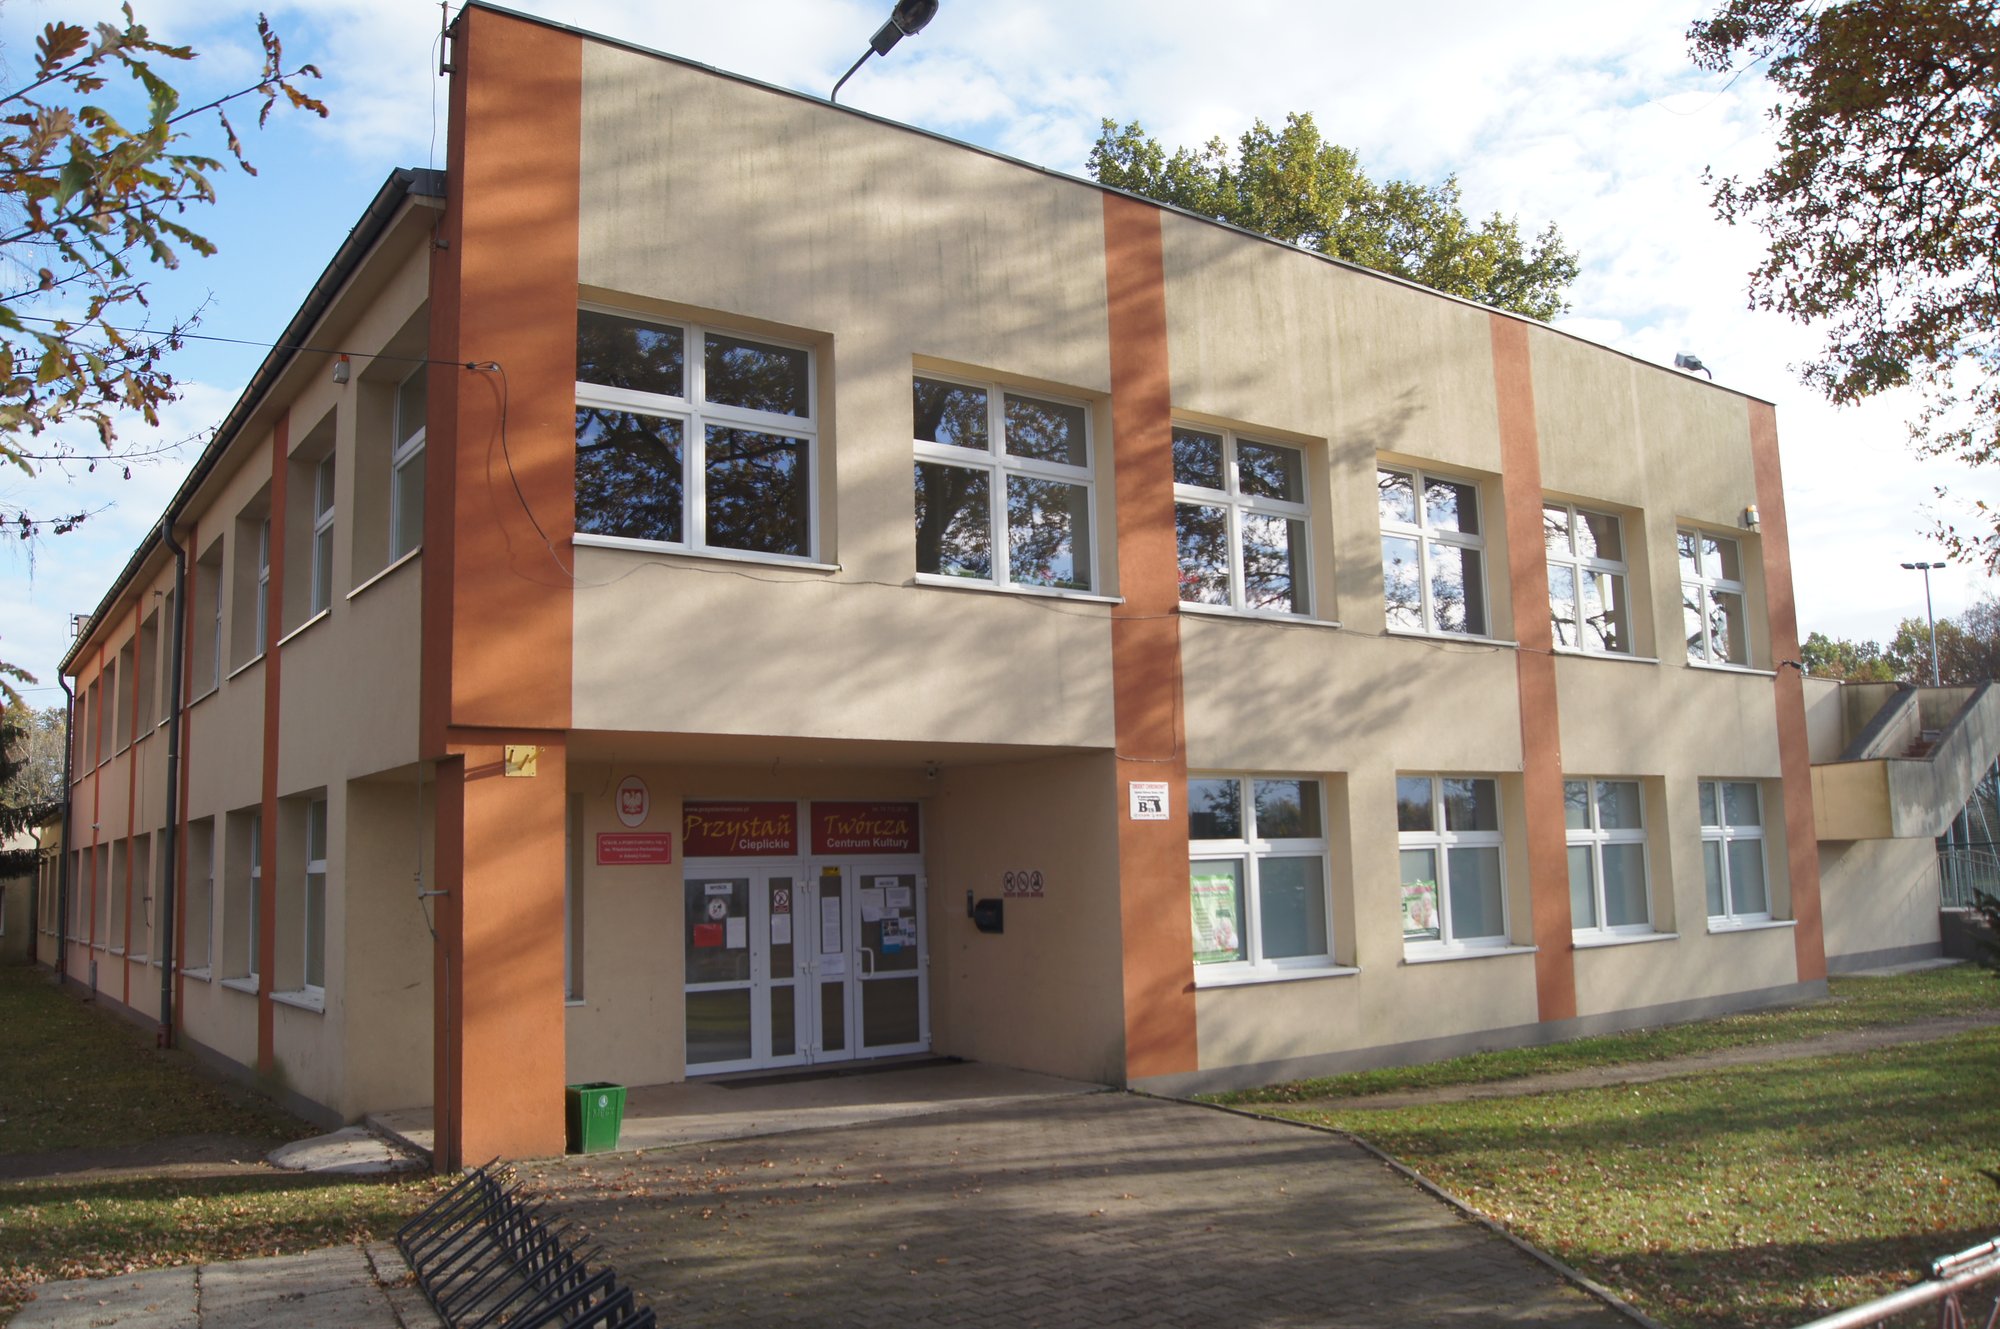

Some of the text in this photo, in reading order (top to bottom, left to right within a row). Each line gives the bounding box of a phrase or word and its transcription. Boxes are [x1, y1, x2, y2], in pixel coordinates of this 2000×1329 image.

[824, 812, 909, 836] Twórcza
[739, 839, 790, 851] Cieplickie
[827, 838, 909, 849] Centrum Kultury
